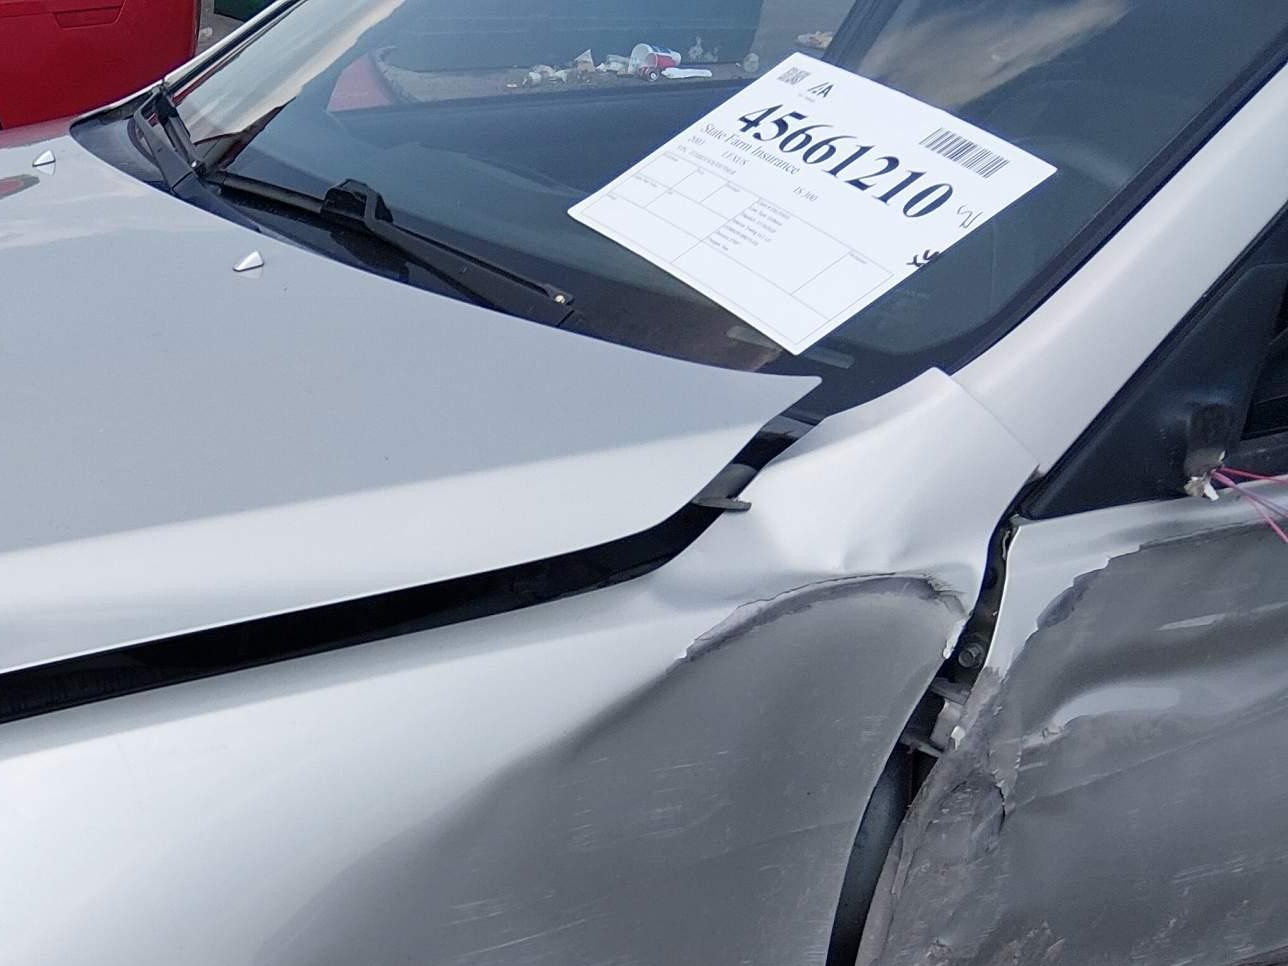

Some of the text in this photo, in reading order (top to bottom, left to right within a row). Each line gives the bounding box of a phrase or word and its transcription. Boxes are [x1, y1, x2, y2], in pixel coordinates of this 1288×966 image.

[701, 122, 727, 141] State
[724, 132, 753, 153] Farm
[751, 145, 801, 175] Insurance
[737, 103, 954, 218] 45661210
